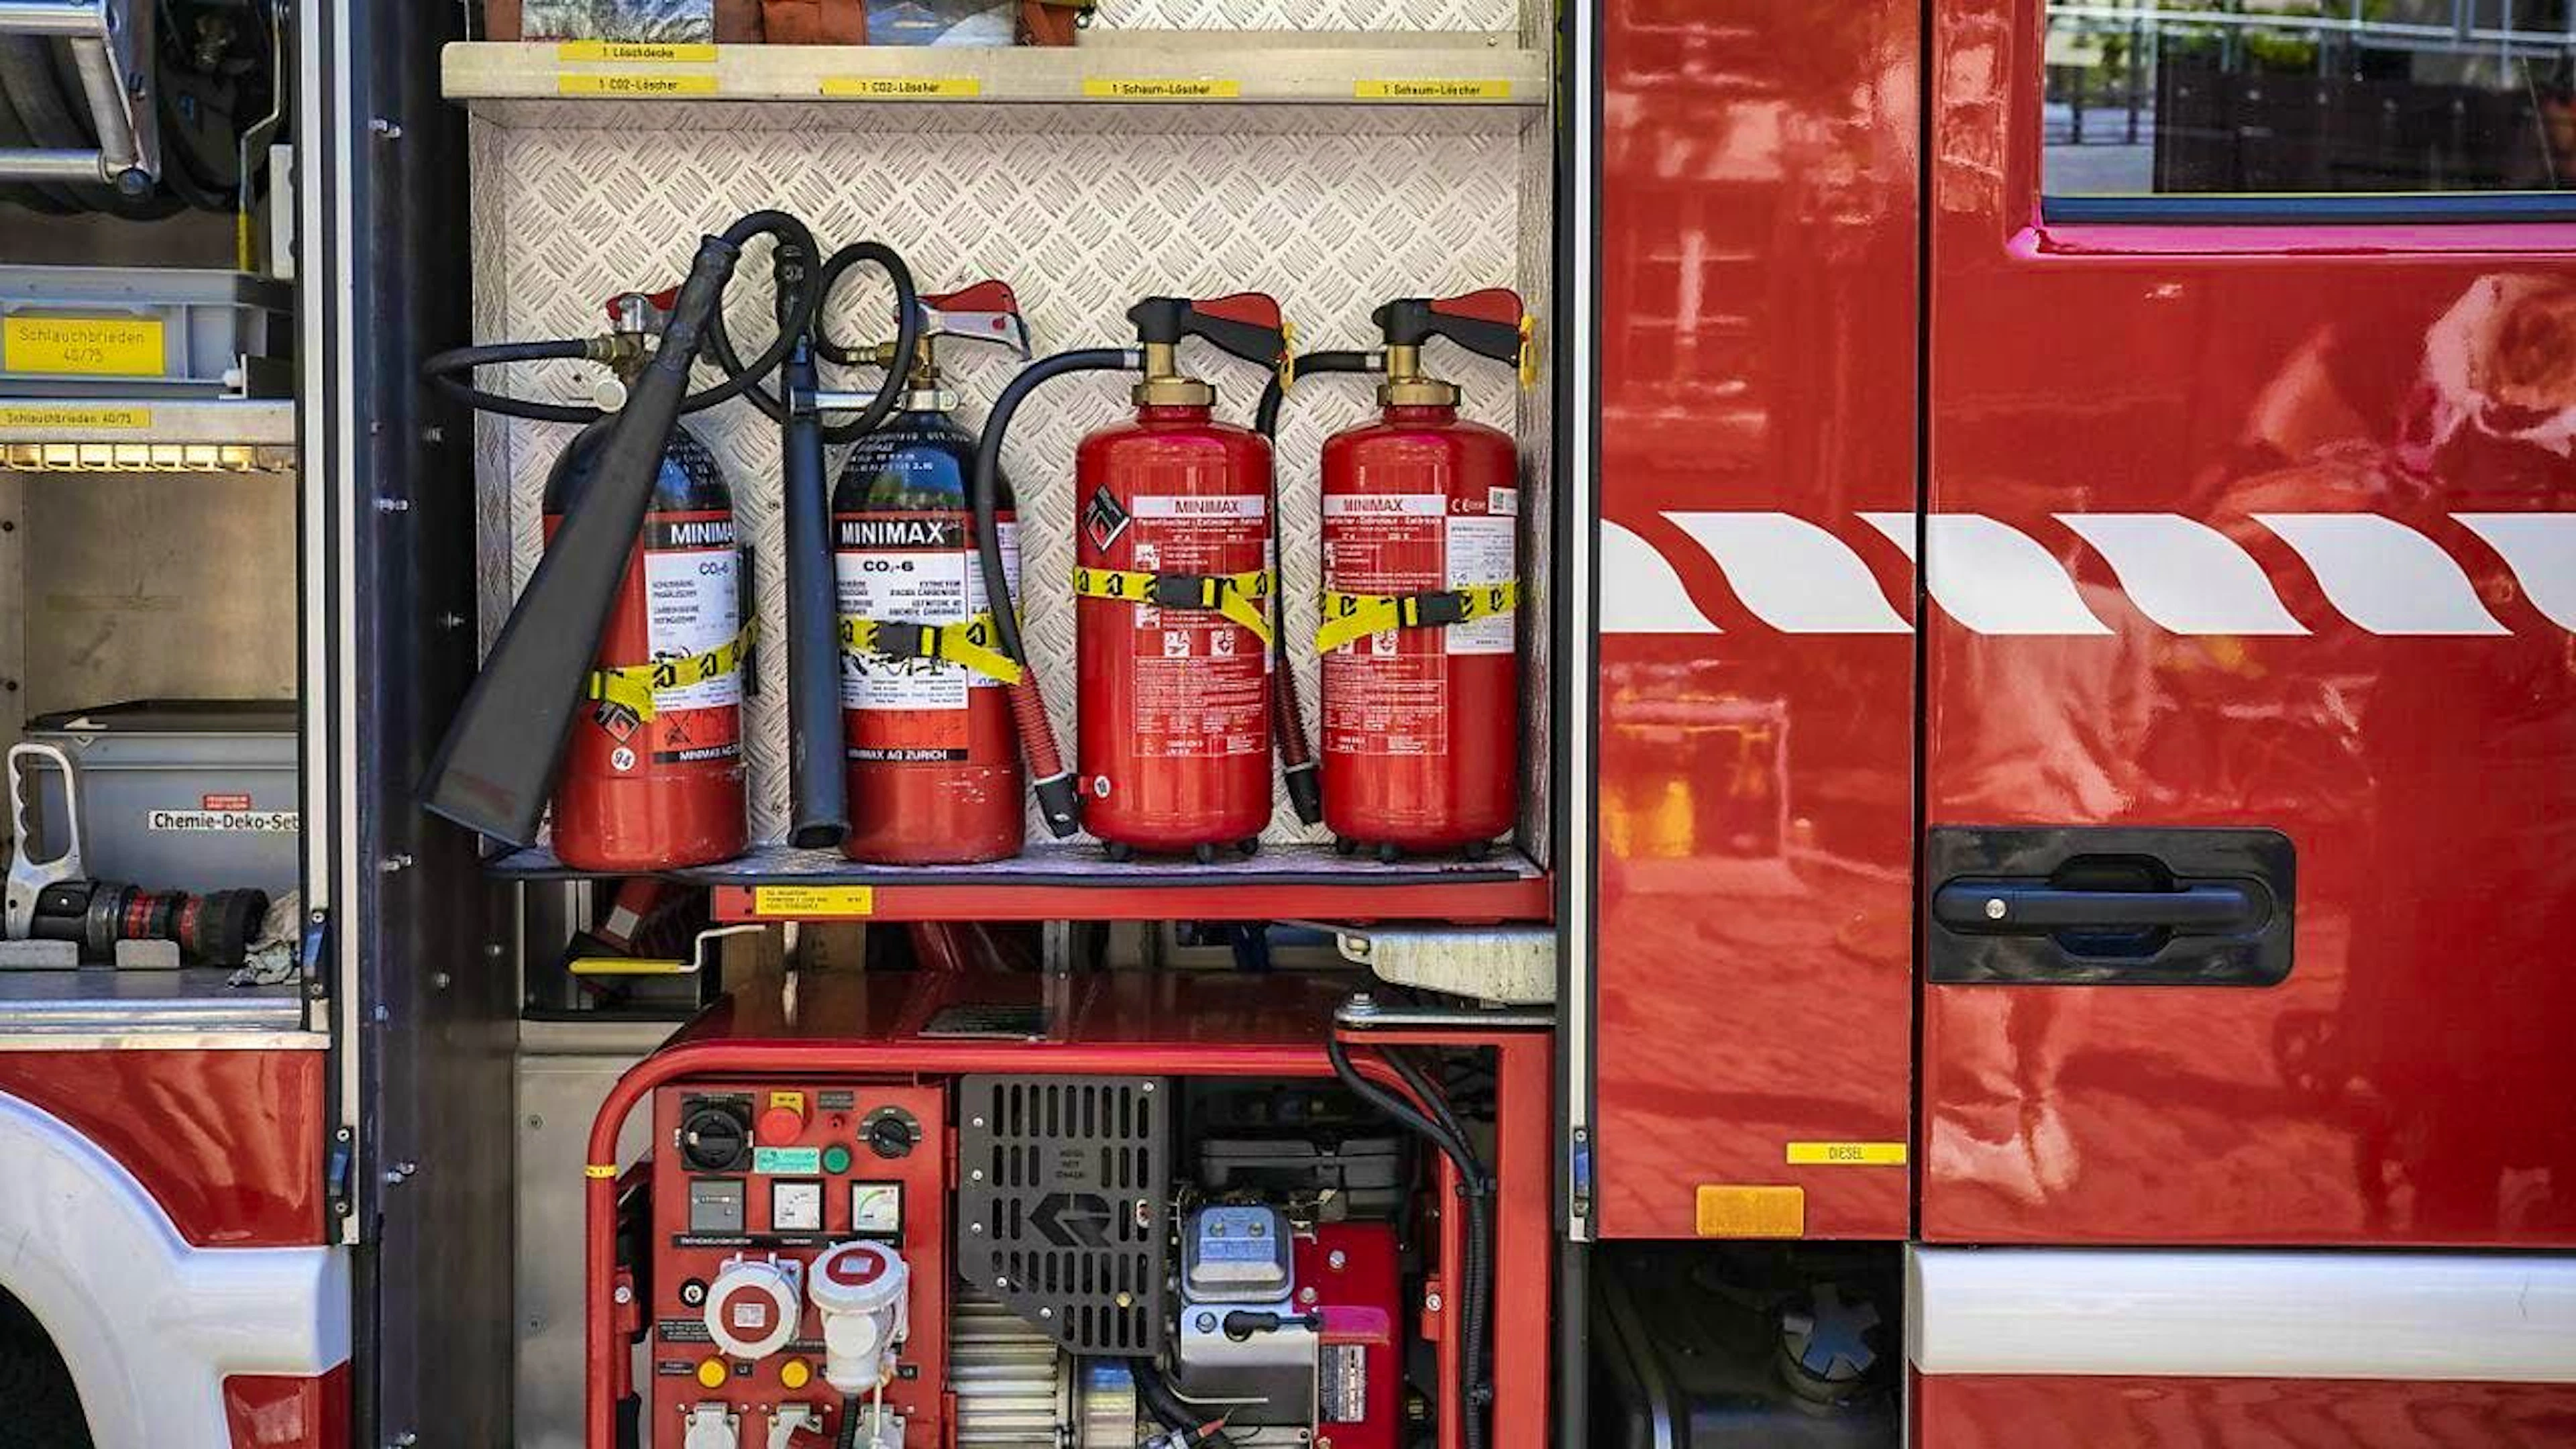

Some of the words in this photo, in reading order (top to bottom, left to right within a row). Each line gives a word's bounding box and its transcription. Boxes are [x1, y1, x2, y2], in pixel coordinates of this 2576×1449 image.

[599, 78, 604, 89] 1
[610, 78, 677, 91] CO2-Löscher
[861, 82, 866, 92] 1
[1112, 84, 1118, 94] 1
[1175, 500, 1240, 513] MINIMAX
[1343, 498, 1404, 512] MINIMAX
[841, 522, 945, 545] MINIMAX
[155, 814, 299, 829] Chemie-Deko-Set
[1829, 1146, 1864, 1159] DIESEL
